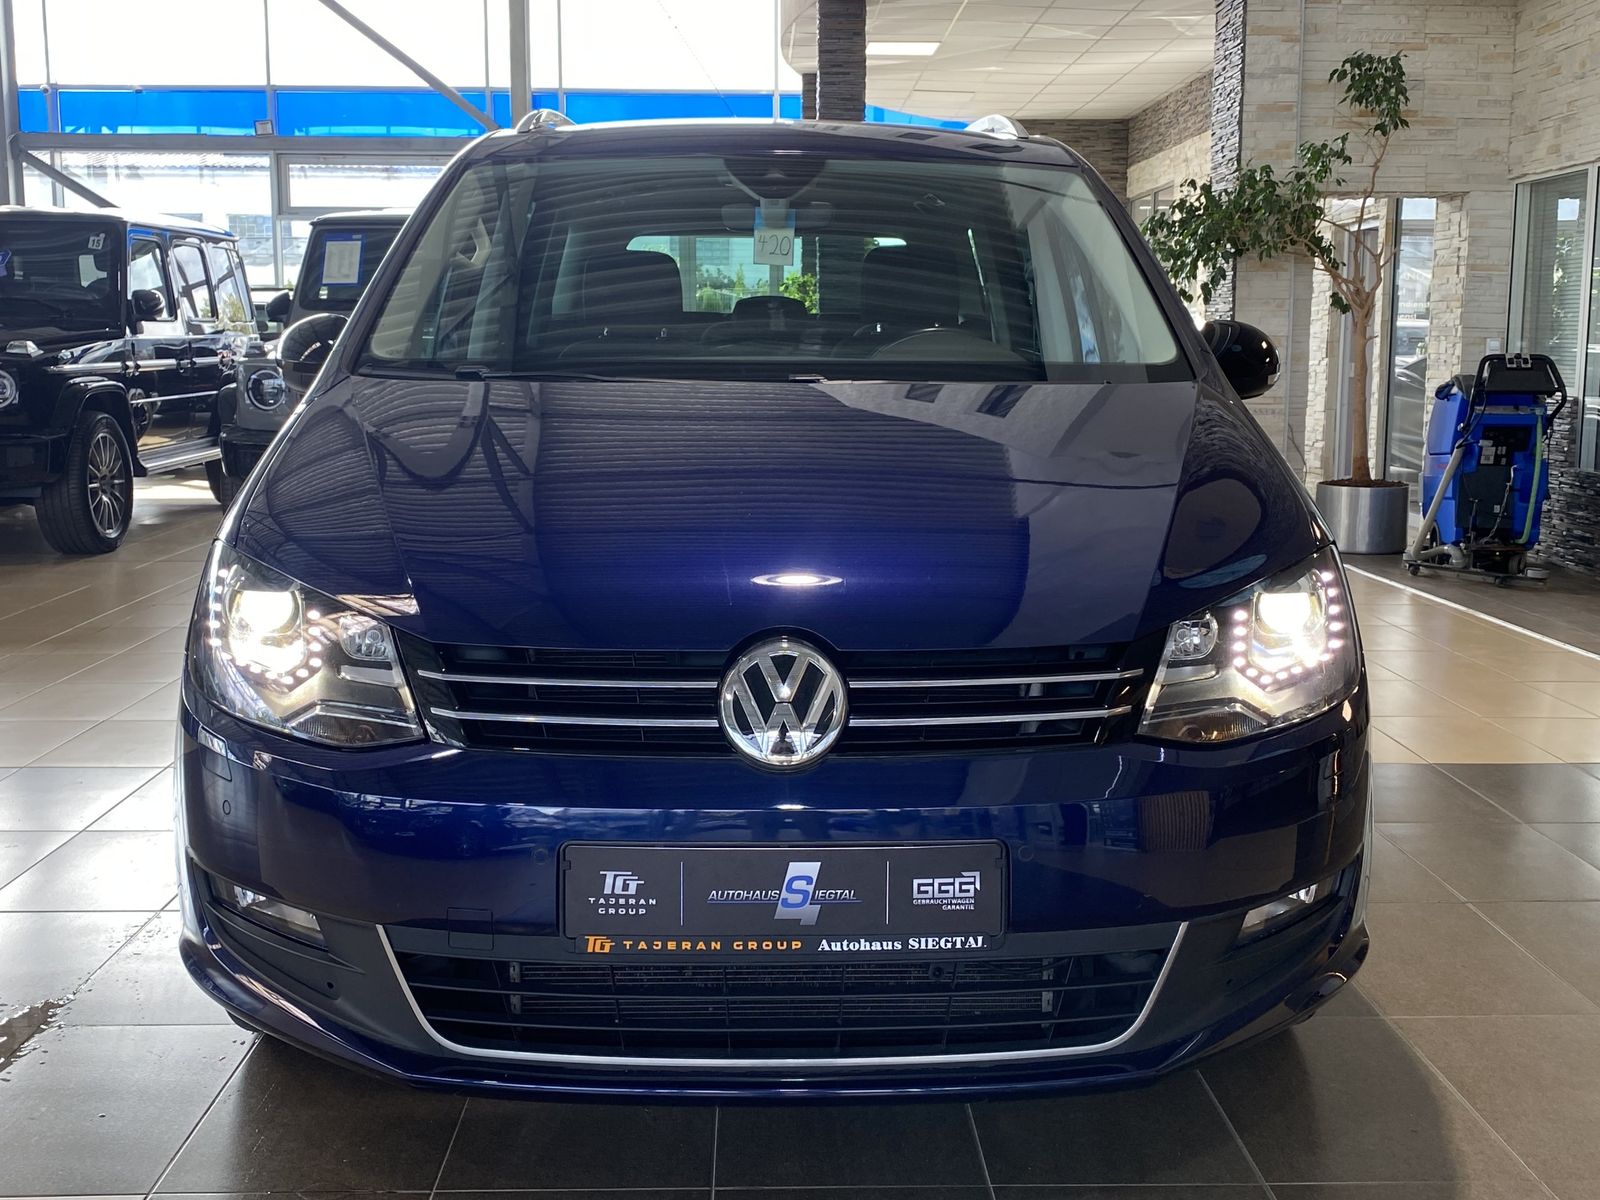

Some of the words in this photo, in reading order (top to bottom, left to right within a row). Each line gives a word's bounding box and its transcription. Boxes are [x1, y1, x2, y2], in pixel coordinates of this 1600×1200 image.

[758, 234, 791, 256] 420
[912, 876, 975, 899] GGG
[588, 896, 657, 906] TAJERAN
[707, 889, 780, 901] AUTOHAUS
[912, 897, 975, 906] GEBRAUCHTWAGEN
[598, 907, 647, 915] GROUP
[622, 940, 721, 950] TAJERAN
[732, 940, 802, 950] GROUP
[817, 937, 902, 952] Autohaus
